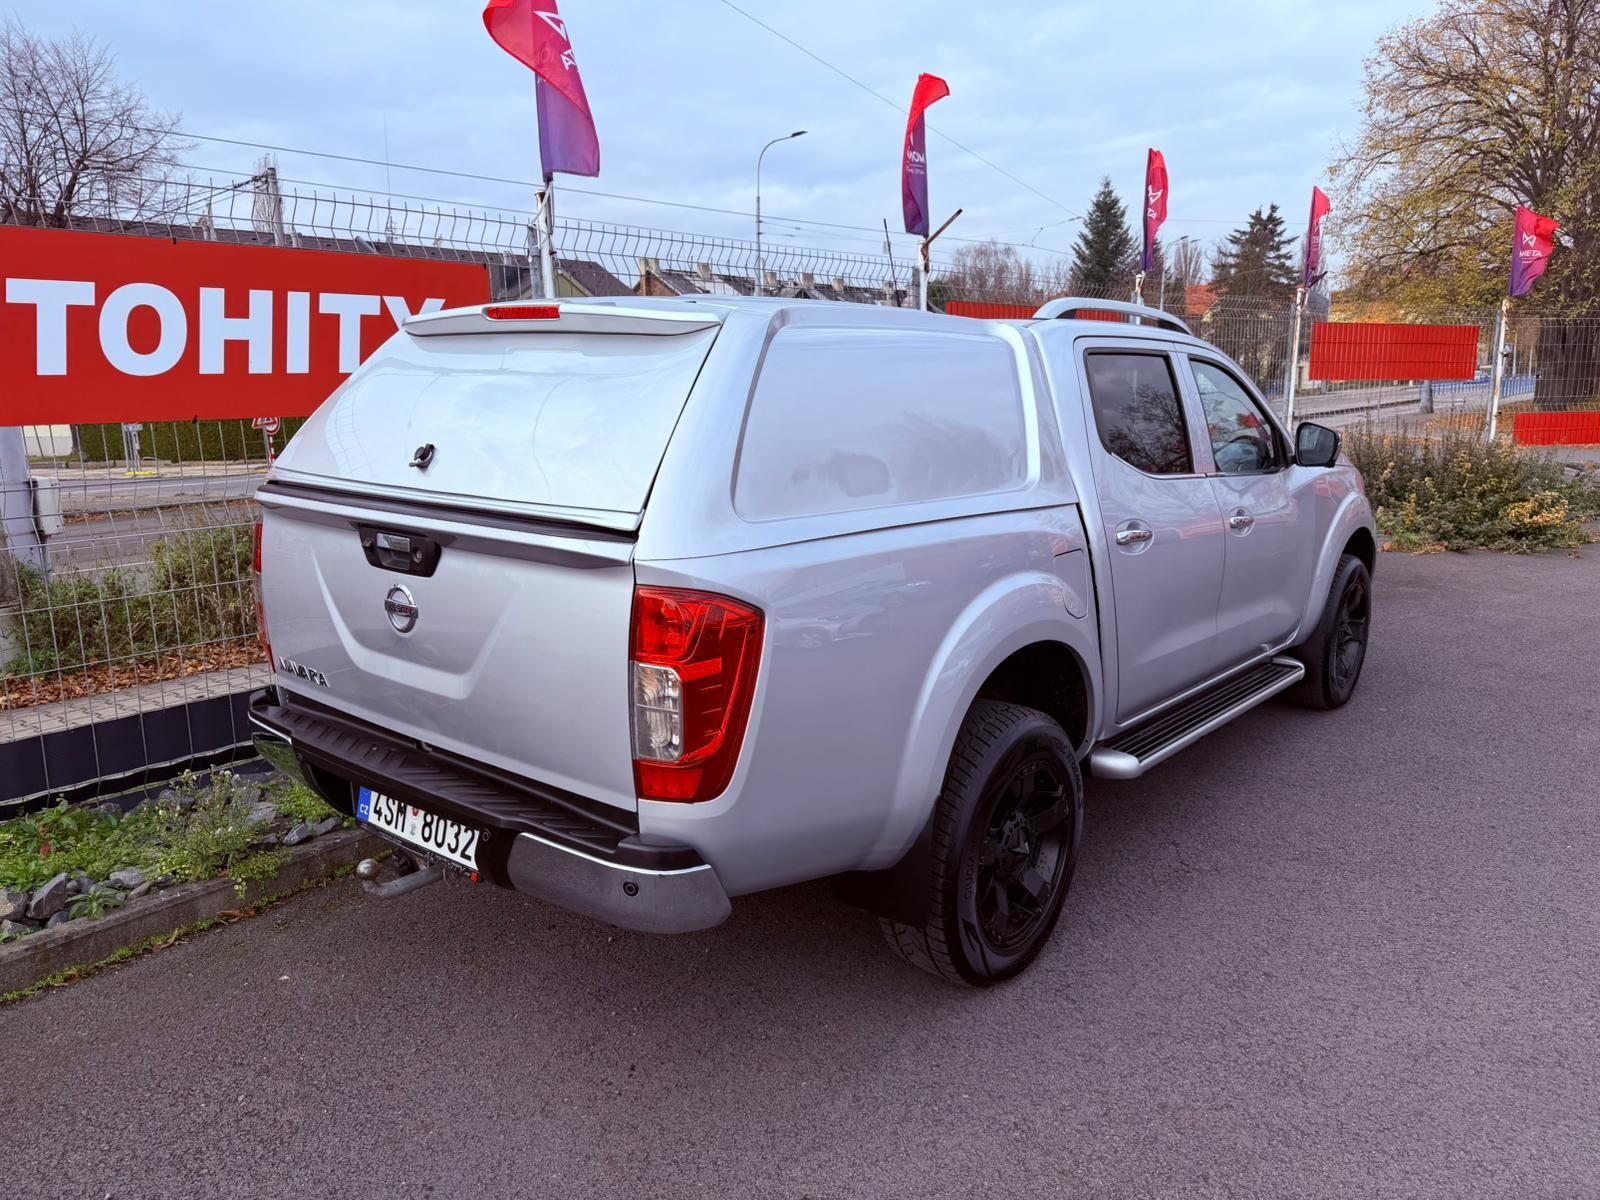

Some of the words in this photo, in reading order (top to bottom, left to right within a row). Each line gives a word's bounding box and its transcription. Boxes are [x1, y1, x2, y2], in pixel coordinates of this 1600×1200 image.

[359, 803, 369, 815] CZ
[373, 793, 407, 833] 4SM
[421, 811, 476, 861] 8032
